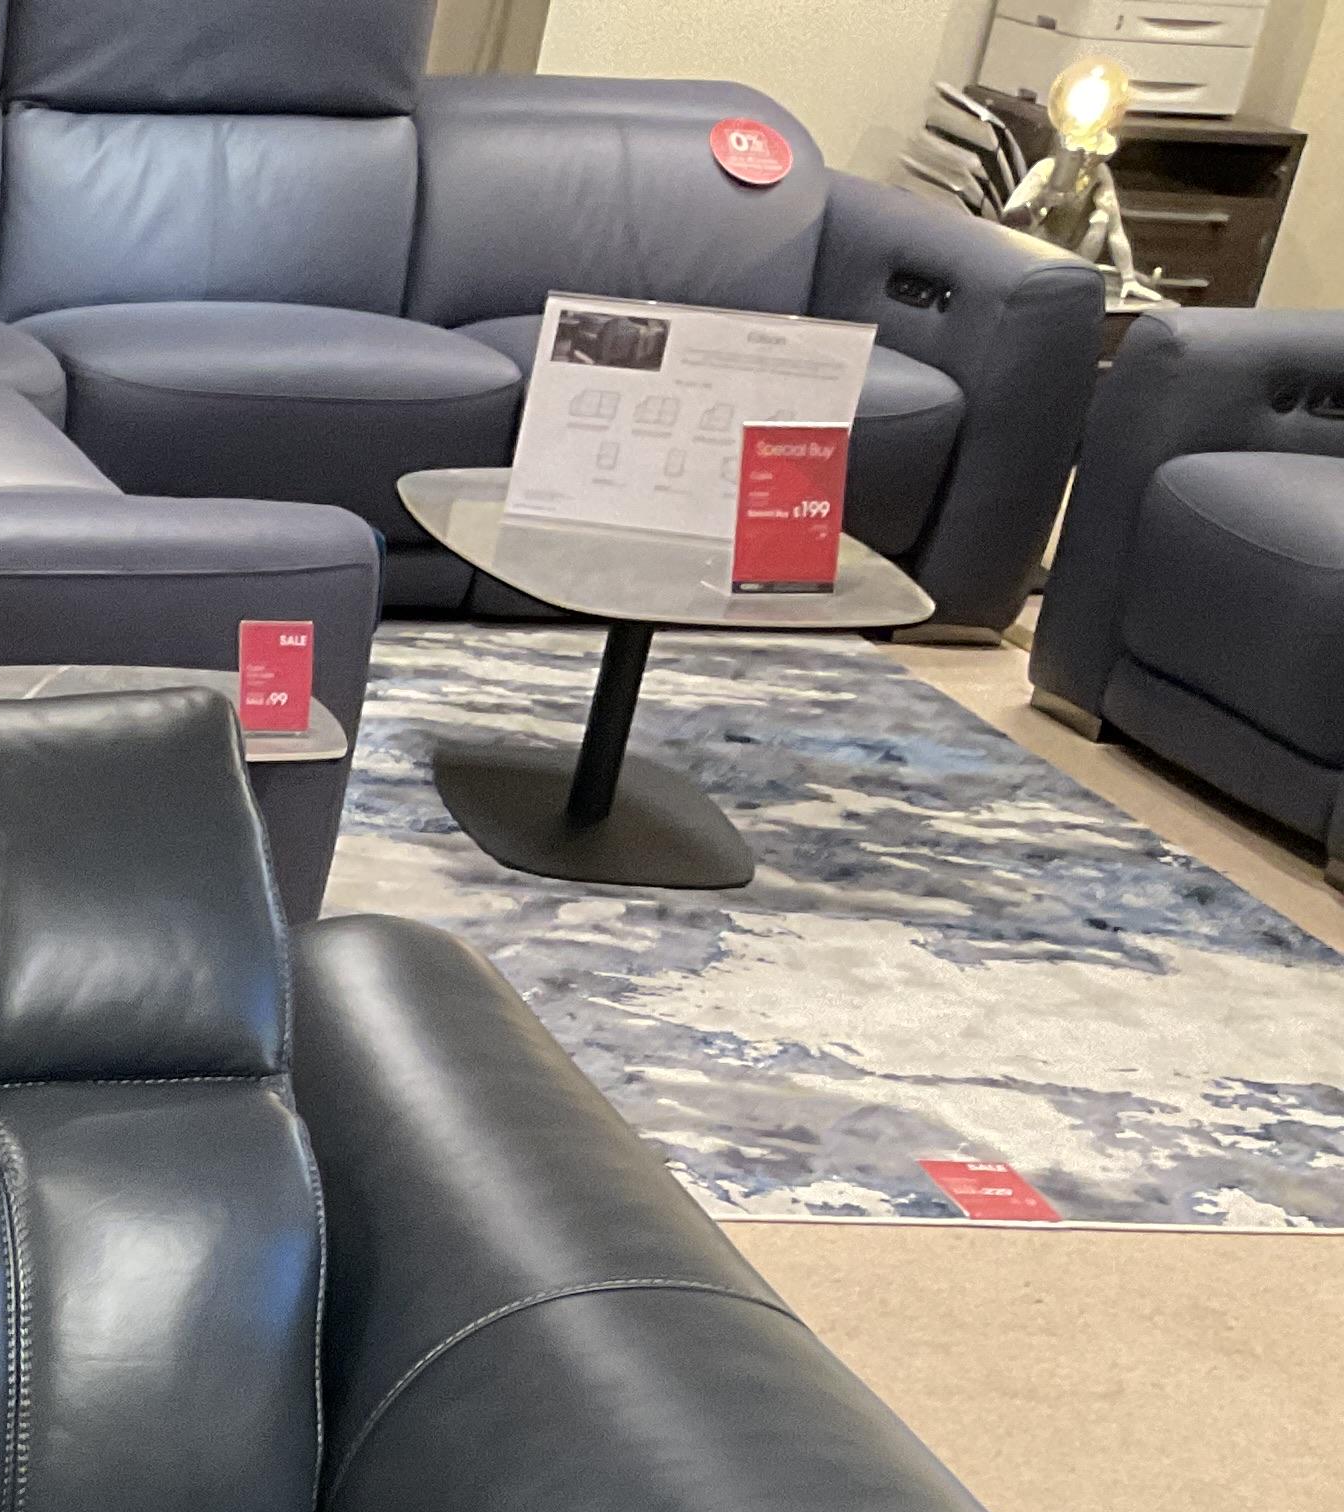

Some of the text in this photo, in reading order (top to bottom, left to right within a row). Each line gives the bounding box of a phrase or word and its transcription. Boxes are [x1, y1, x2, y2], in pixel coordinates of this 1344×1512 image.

[810, 442, 835, 460] Buy
[792, 501, 831, 519] £199
[279, 635, 307, 647] SALE
